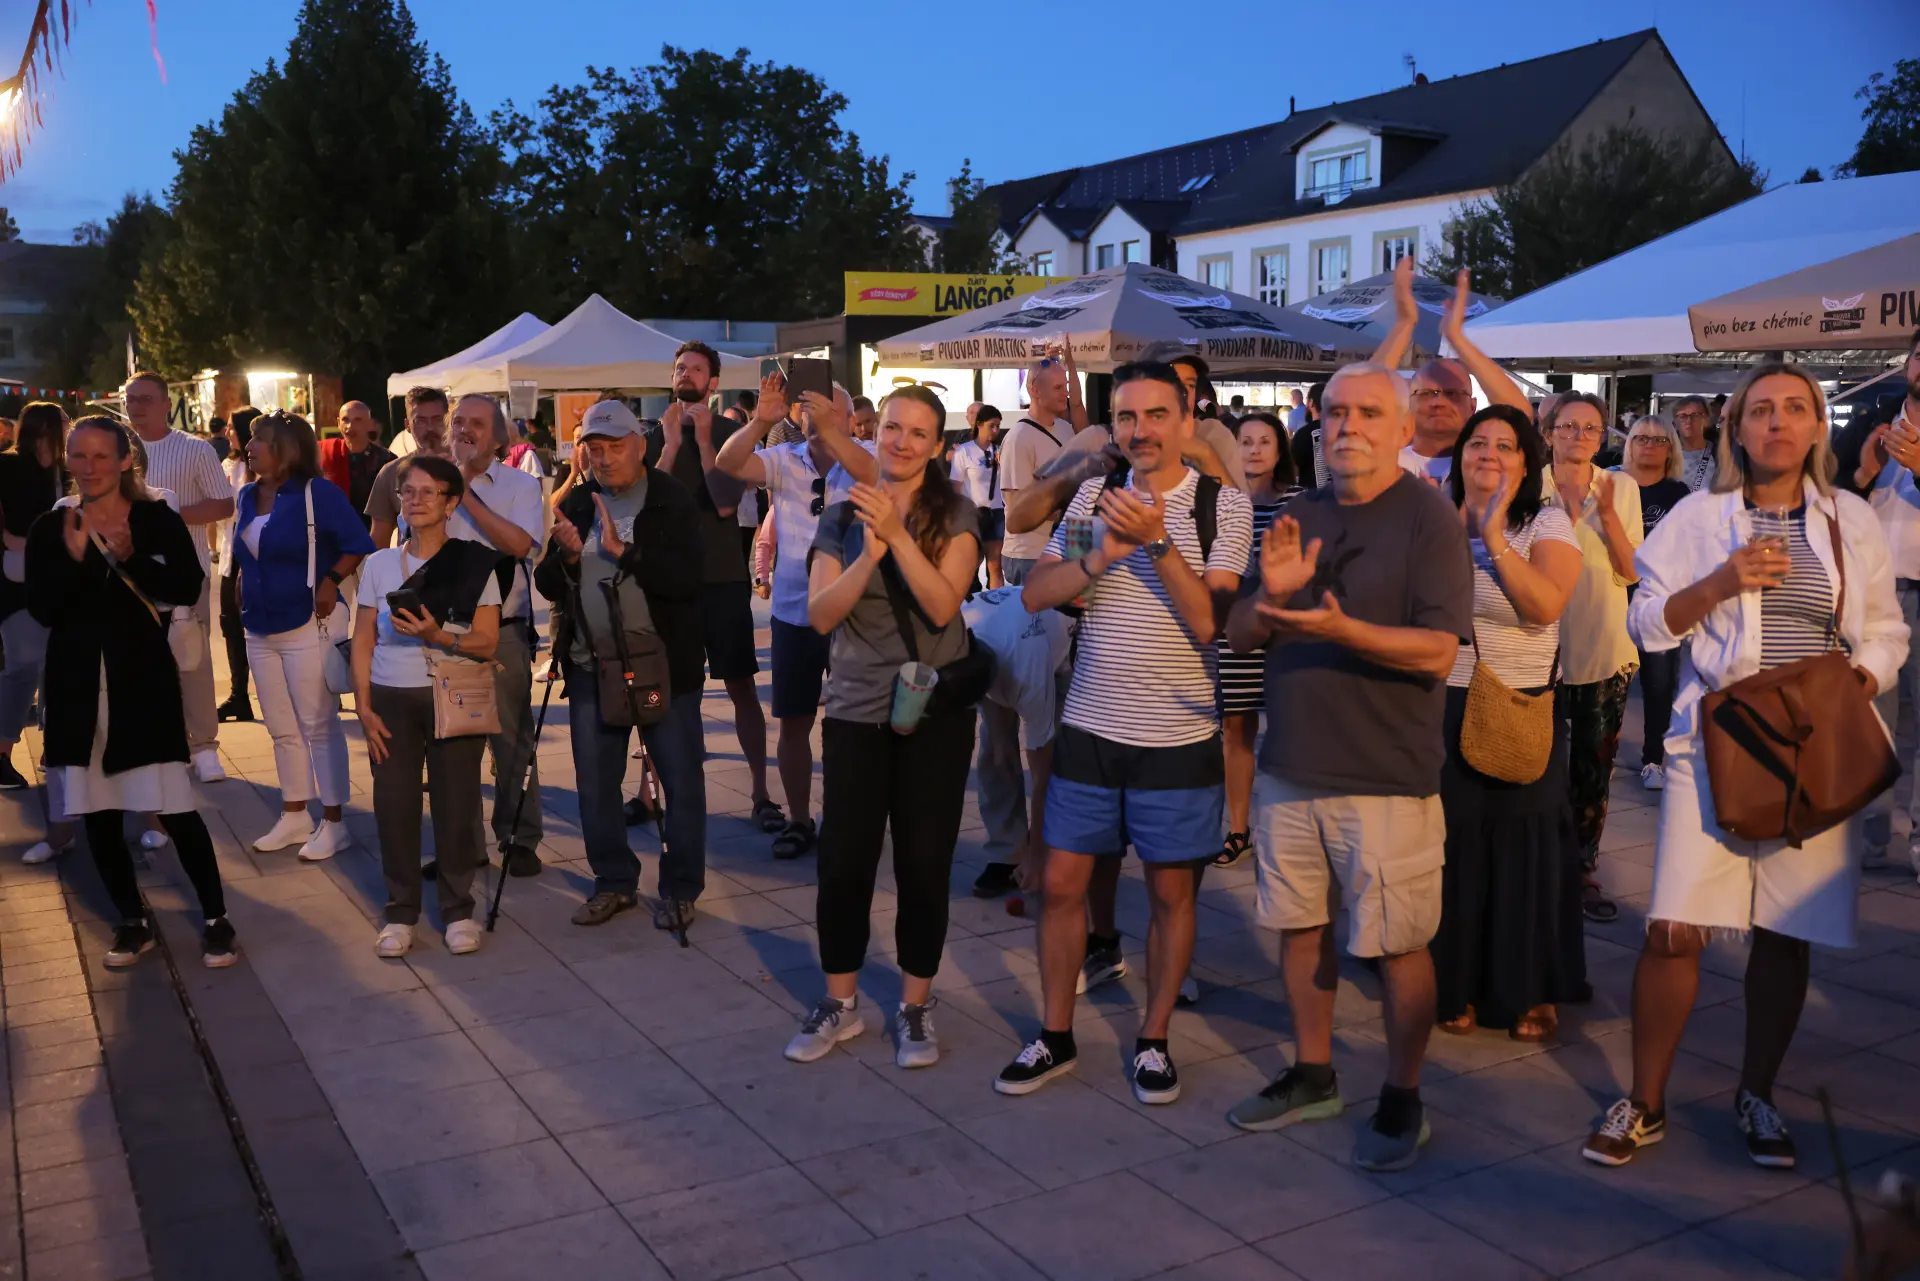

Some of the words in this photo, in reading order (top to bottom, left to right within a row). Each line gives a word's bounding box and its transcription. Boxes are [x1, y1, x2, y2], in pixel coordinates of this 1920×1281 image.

[935, 278, 1014, 312] LANGOŠ
[1704, 321, 1727, 338] pivo
[1732, 316, 1757, 332] bez
[1763, 310, 1813, 330] chémie
[938, 337, 980, 360] PIVOVAR
[984, 338, 1027, 358] MARTINS
[1080, 341, 1106, 352] chémie
[1206, 337, 1255, 357] PIVOVAR
[1260, 339, 1314, 361] MARTINS
